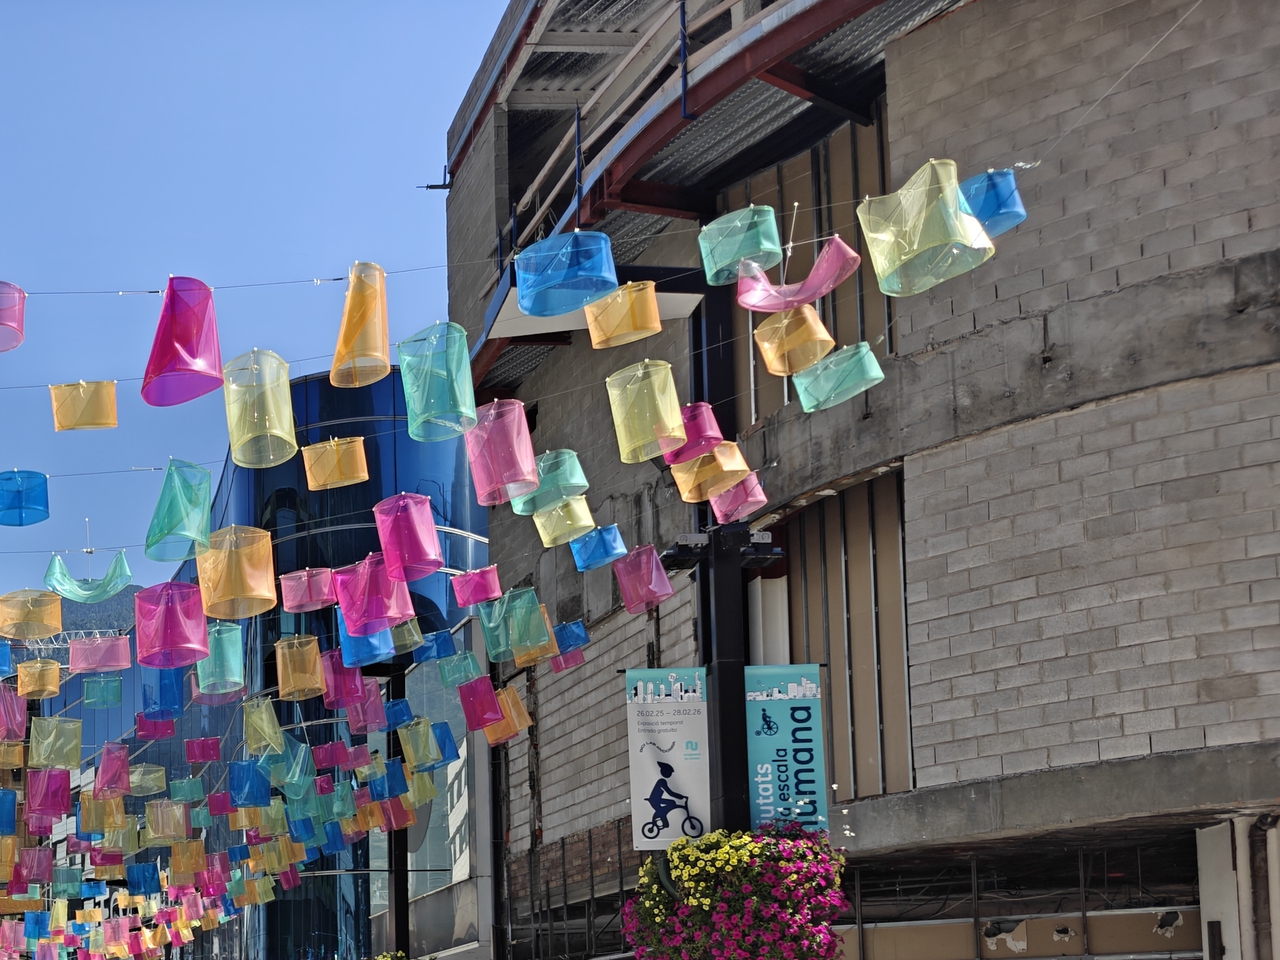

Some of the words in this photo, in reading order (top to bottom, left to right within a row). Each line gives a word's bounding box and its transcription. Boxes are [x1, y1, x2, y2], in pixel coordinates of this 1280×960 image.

[672, 708, 701, 716] 28.02.26
[754, 764, 774, 823] iutats
[772, 748, 790, 801] escala
